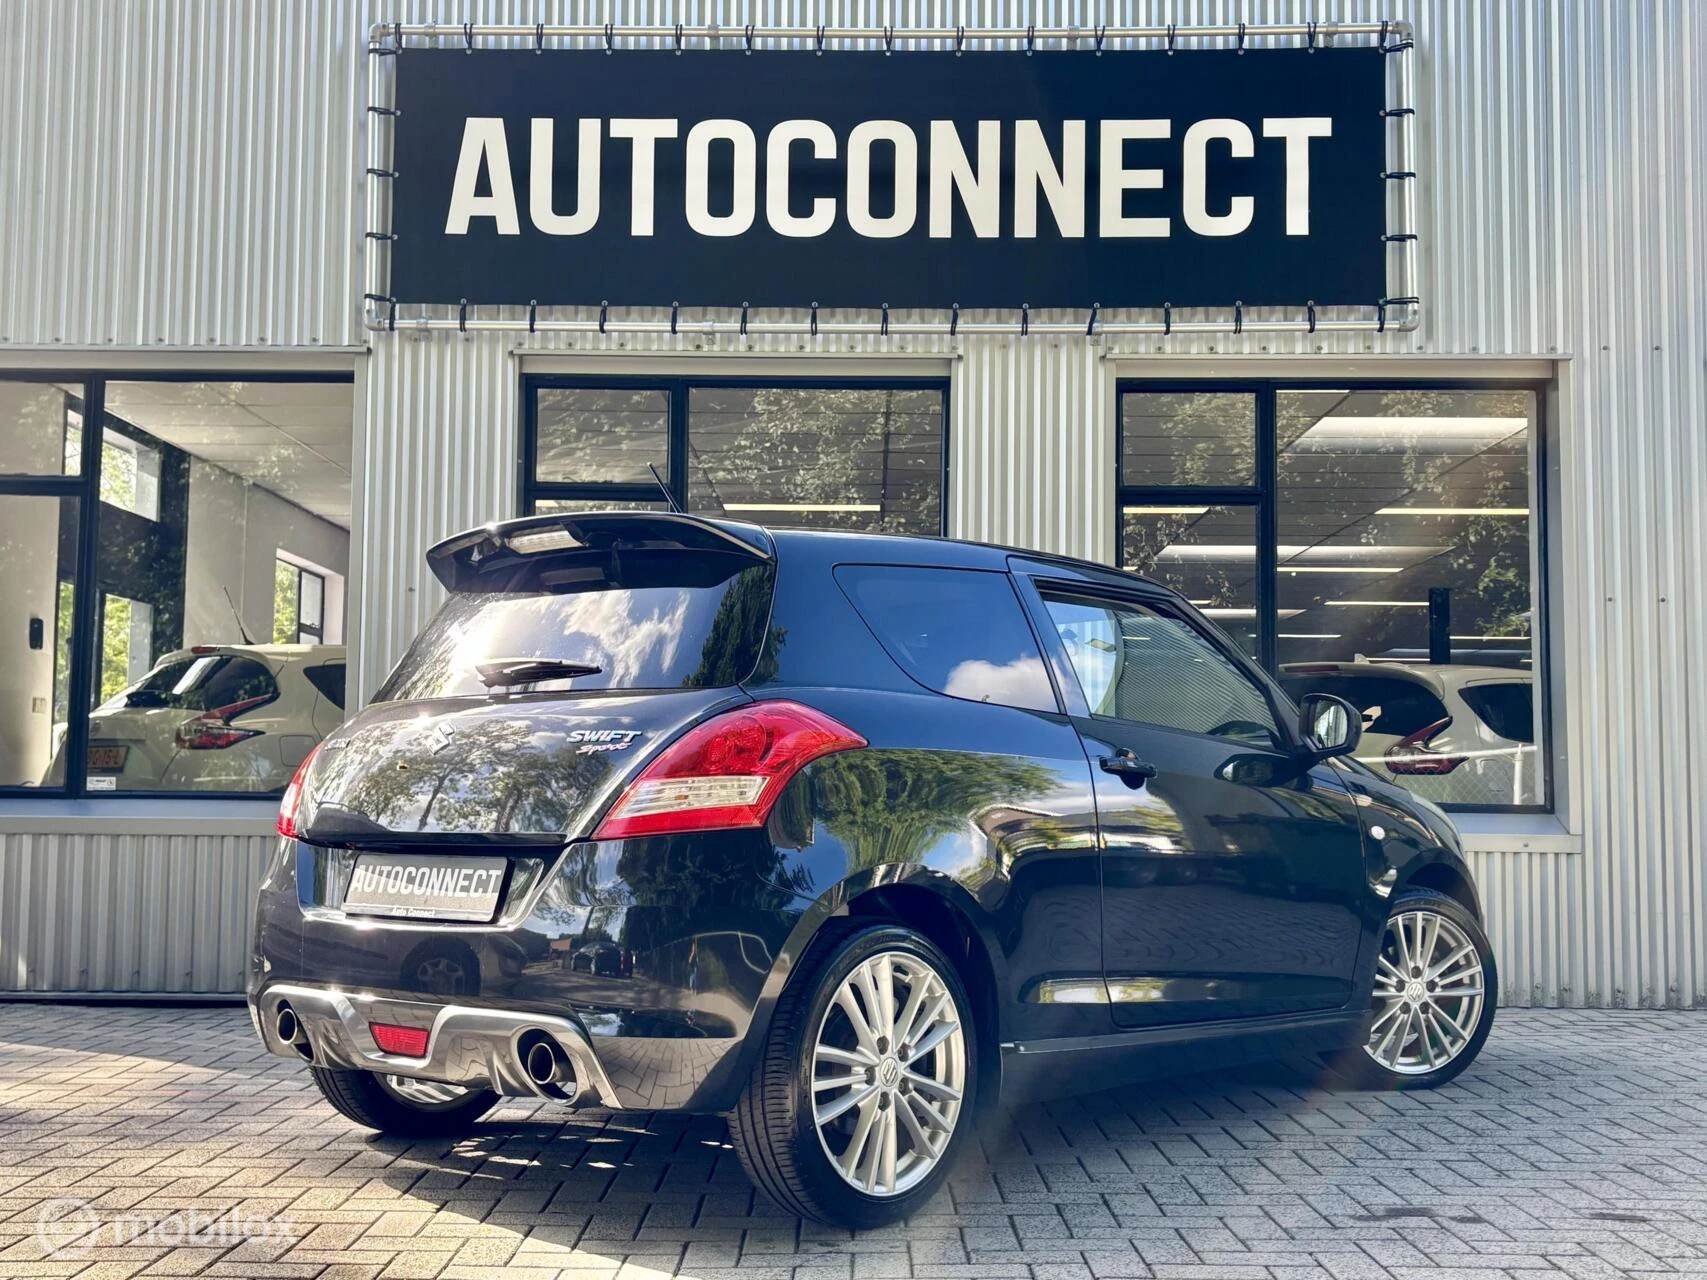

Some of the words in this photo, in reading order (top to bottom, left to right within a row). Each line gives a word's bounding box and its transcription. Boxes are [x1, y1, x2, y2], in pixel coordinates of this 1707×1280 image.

[444, 117, 1333, 239] AUTOCONNECT
[566, 730, 642, 743] SWIFT
[350, 864, 502, 898] AUTOCONNECT
